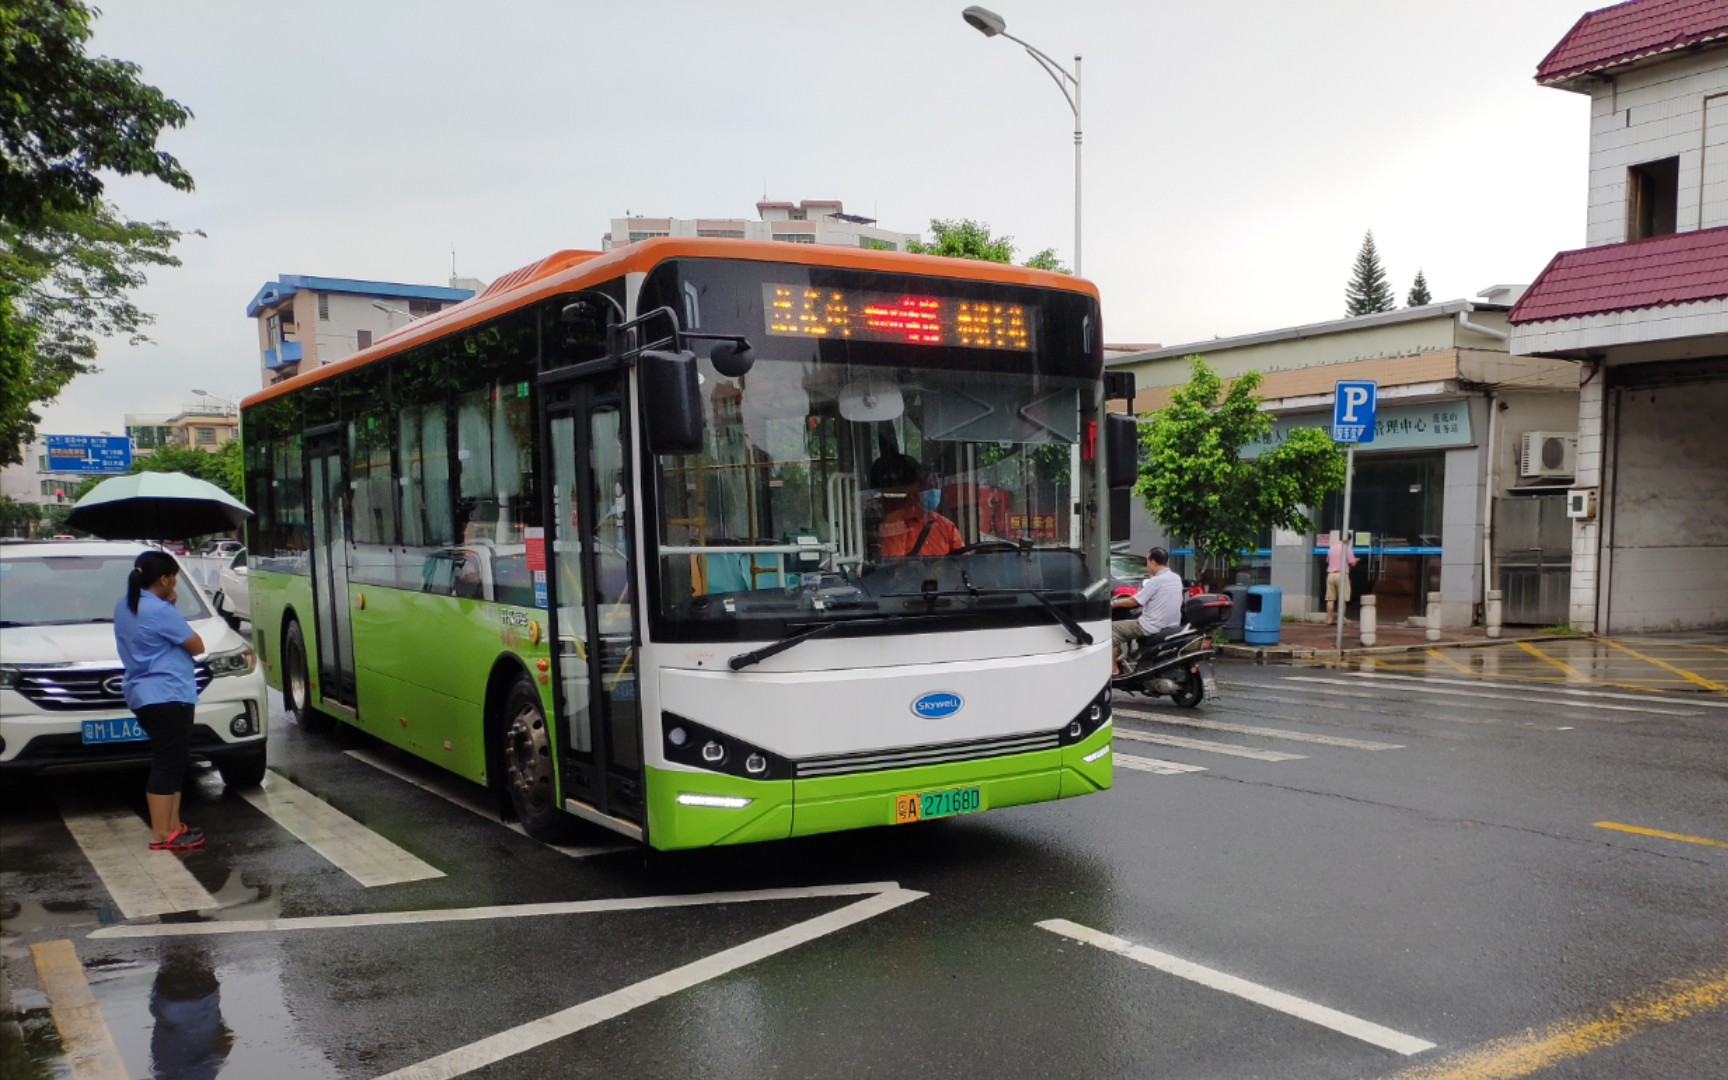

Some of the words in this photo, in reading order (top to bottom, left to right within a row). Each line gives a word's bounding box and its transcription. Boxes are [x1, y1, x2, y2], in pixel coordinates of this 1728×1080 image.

[1343, 387, 1368, 422] P
[1375, 416, 1427, 436] 管理中心
[917, 698, 958, 711] Skywell
